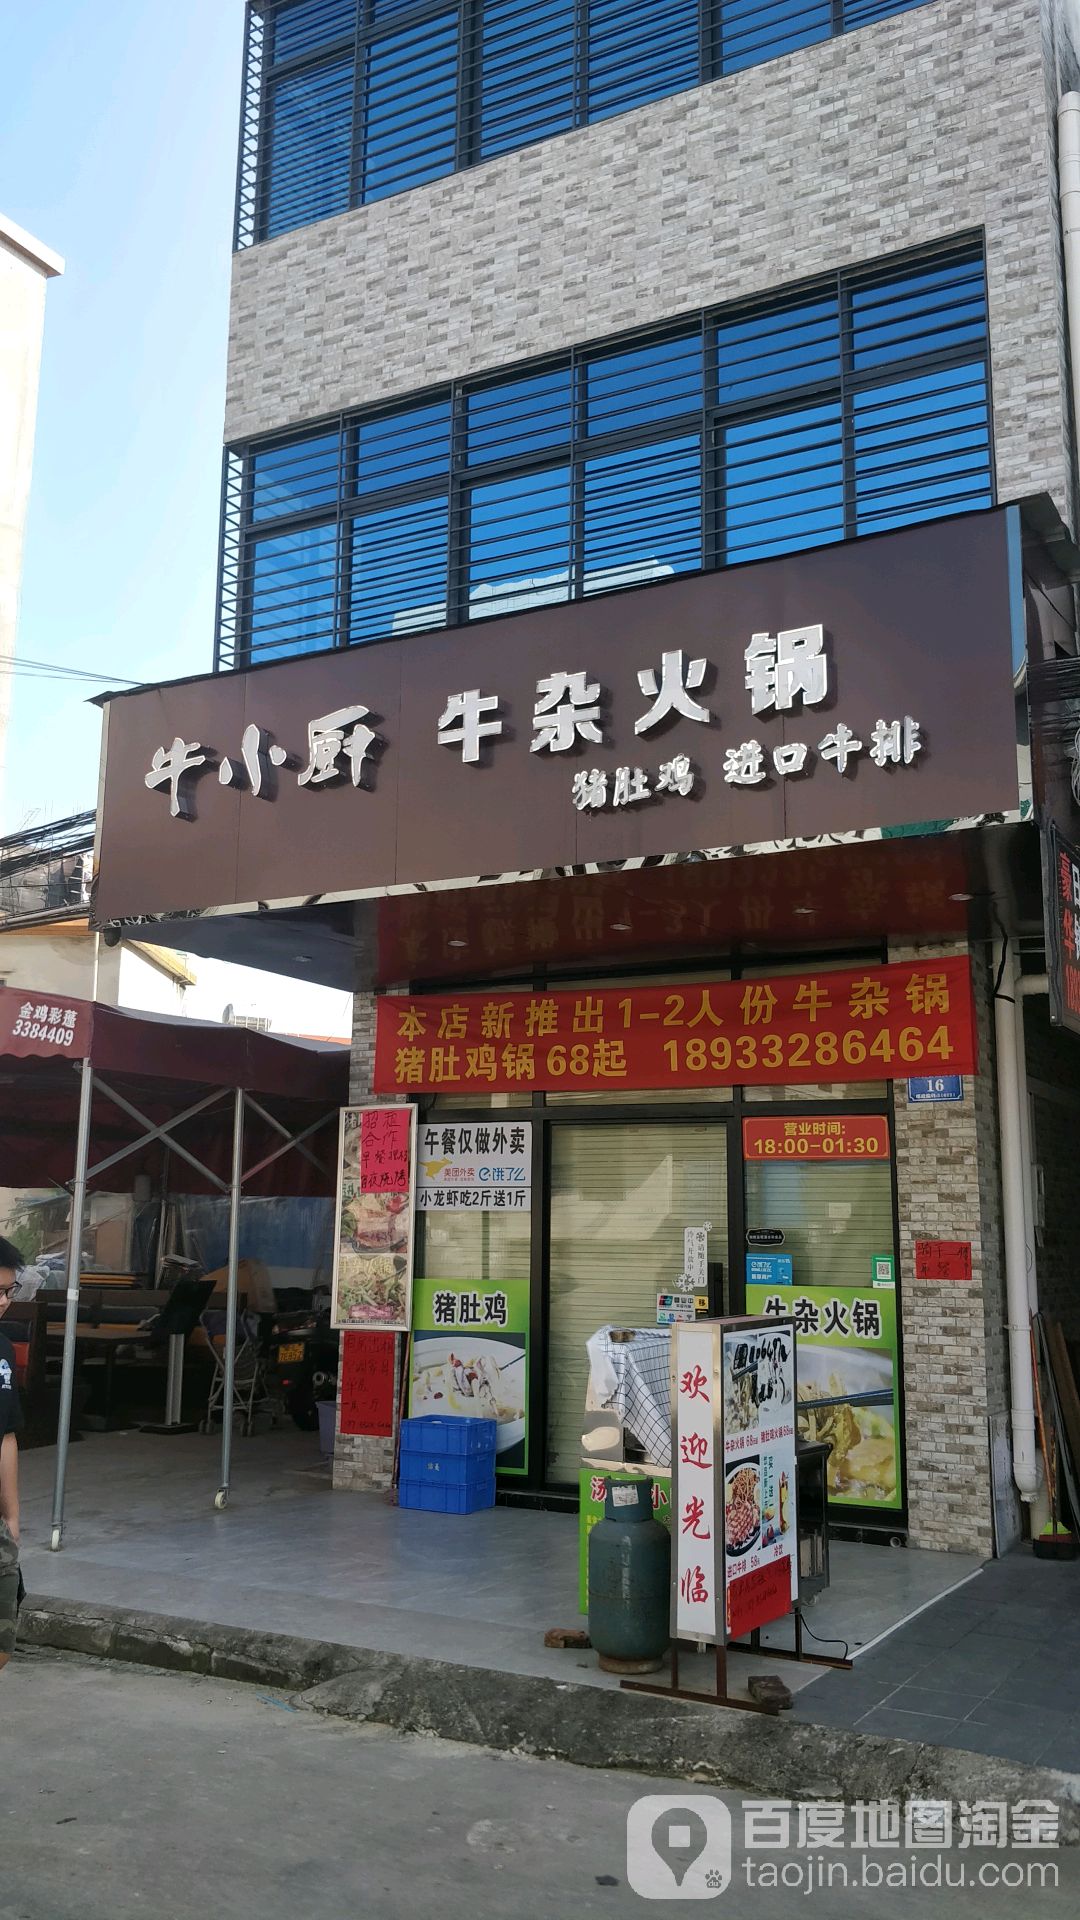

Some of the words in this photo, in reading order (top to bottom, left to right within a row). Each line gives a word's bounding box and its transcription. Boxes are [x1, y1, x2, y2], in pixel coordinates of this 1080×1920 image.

[437, 623, 830, 765] 牛杂火锅
[145, 704, 381, 818] 牛小厨
[572, 753, 697, 813] 猪肚鸡
[723, 715, 923, 786] 进口牛排
[397, 971, 951, 1043] 本店新推出1-2人份牛杂锅
[12, 1019, 74, 1047] 3384409
[395, 1040, 628, 1084] 猪肚鸡锅68起
[662, 1024, 954, 1073] 18933286464
[927, 1078, 944, 1092] 16
[424, 1126, 526, 1156] 午餐仅做外卖
[754, 1137, 879, 1155] 18:00-01:30
[444, 1167, 475, 1177] 美团外卖
[420, 1189, 527, 1207] 小龙虾吃2斤送1斤
[433, 1290, 508, 1327] 猪肚鸡
[679, 1363, 713, 1605] 欢迎光临
